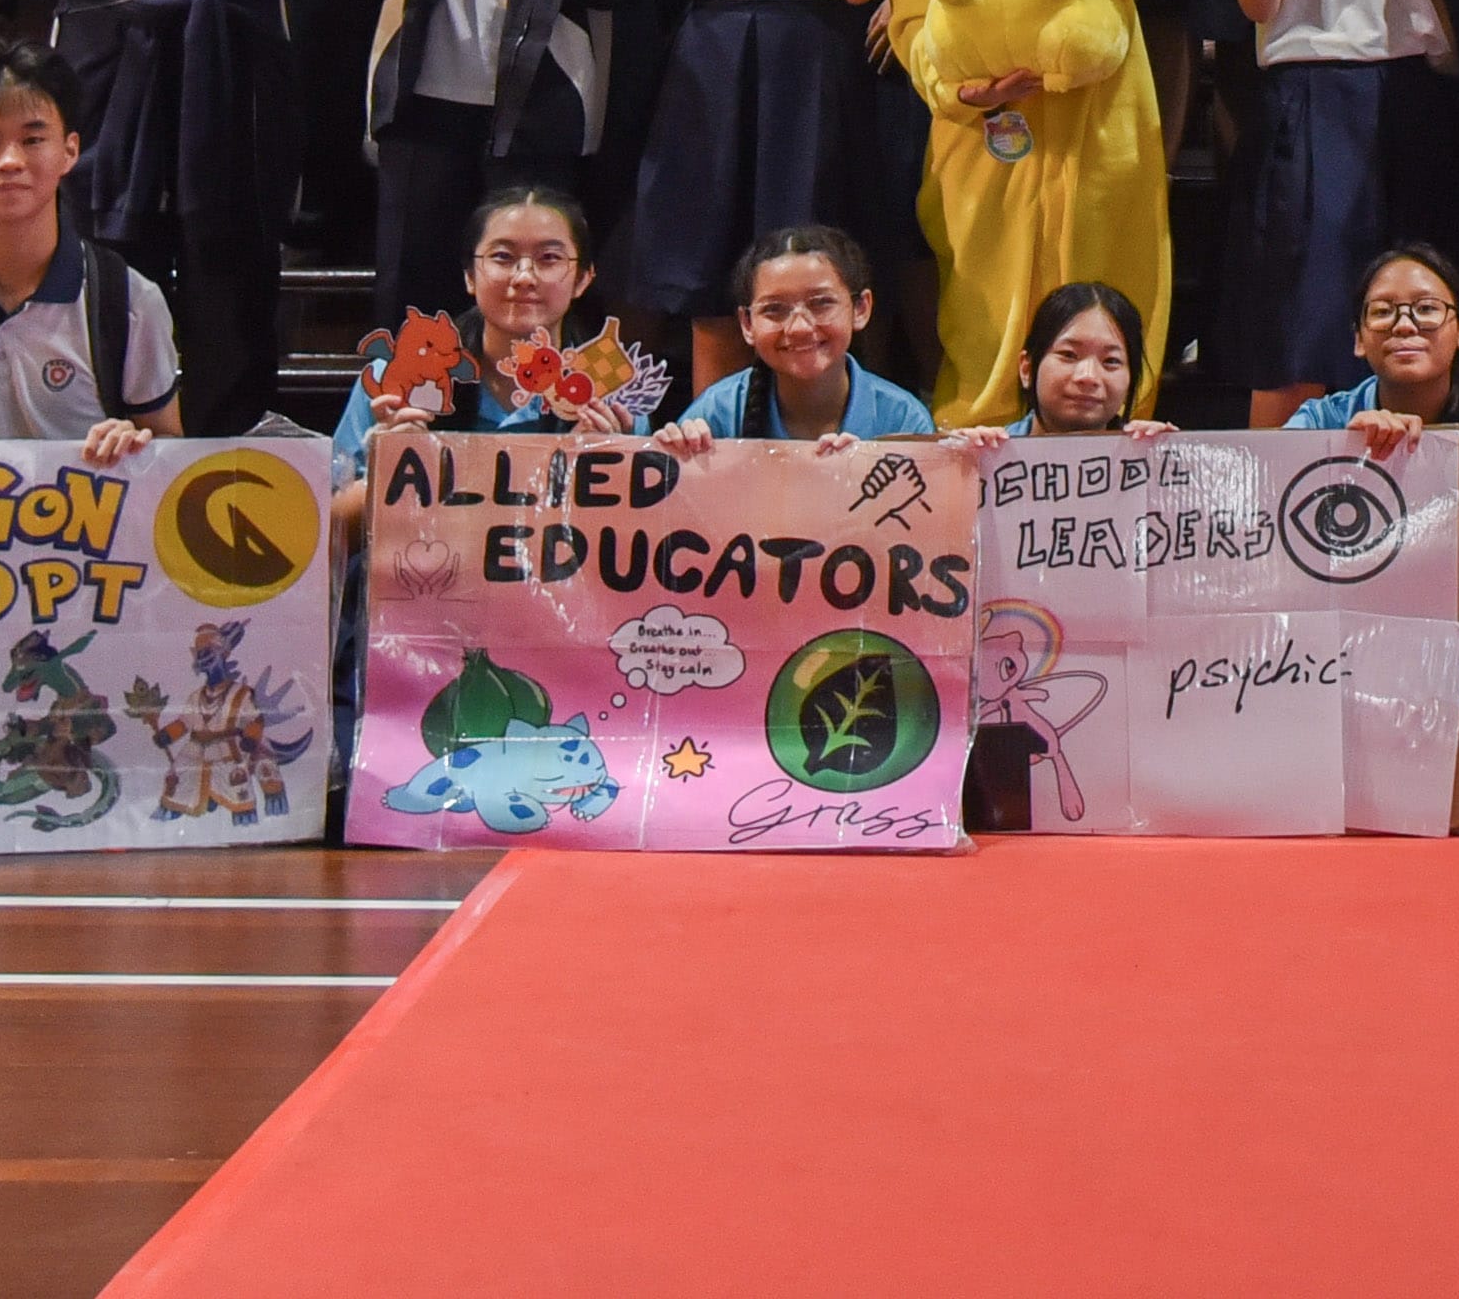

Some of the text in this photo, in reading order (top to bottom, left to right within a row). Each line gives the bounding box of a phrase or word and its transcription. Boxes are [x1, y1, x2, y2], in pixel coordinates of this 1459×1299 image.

[385, 446, 680, 510] ALLIED
[484, 525, 972, 620] EDUCATORS
[1017, 510, 1276, 572] LEADERS
[638, 624, 683, 637] Breathe
[646, 659, 712, 679] Stay calm
[1166, 639, 1352, 719] psychic
[727, 777, 946, 845] Grass
